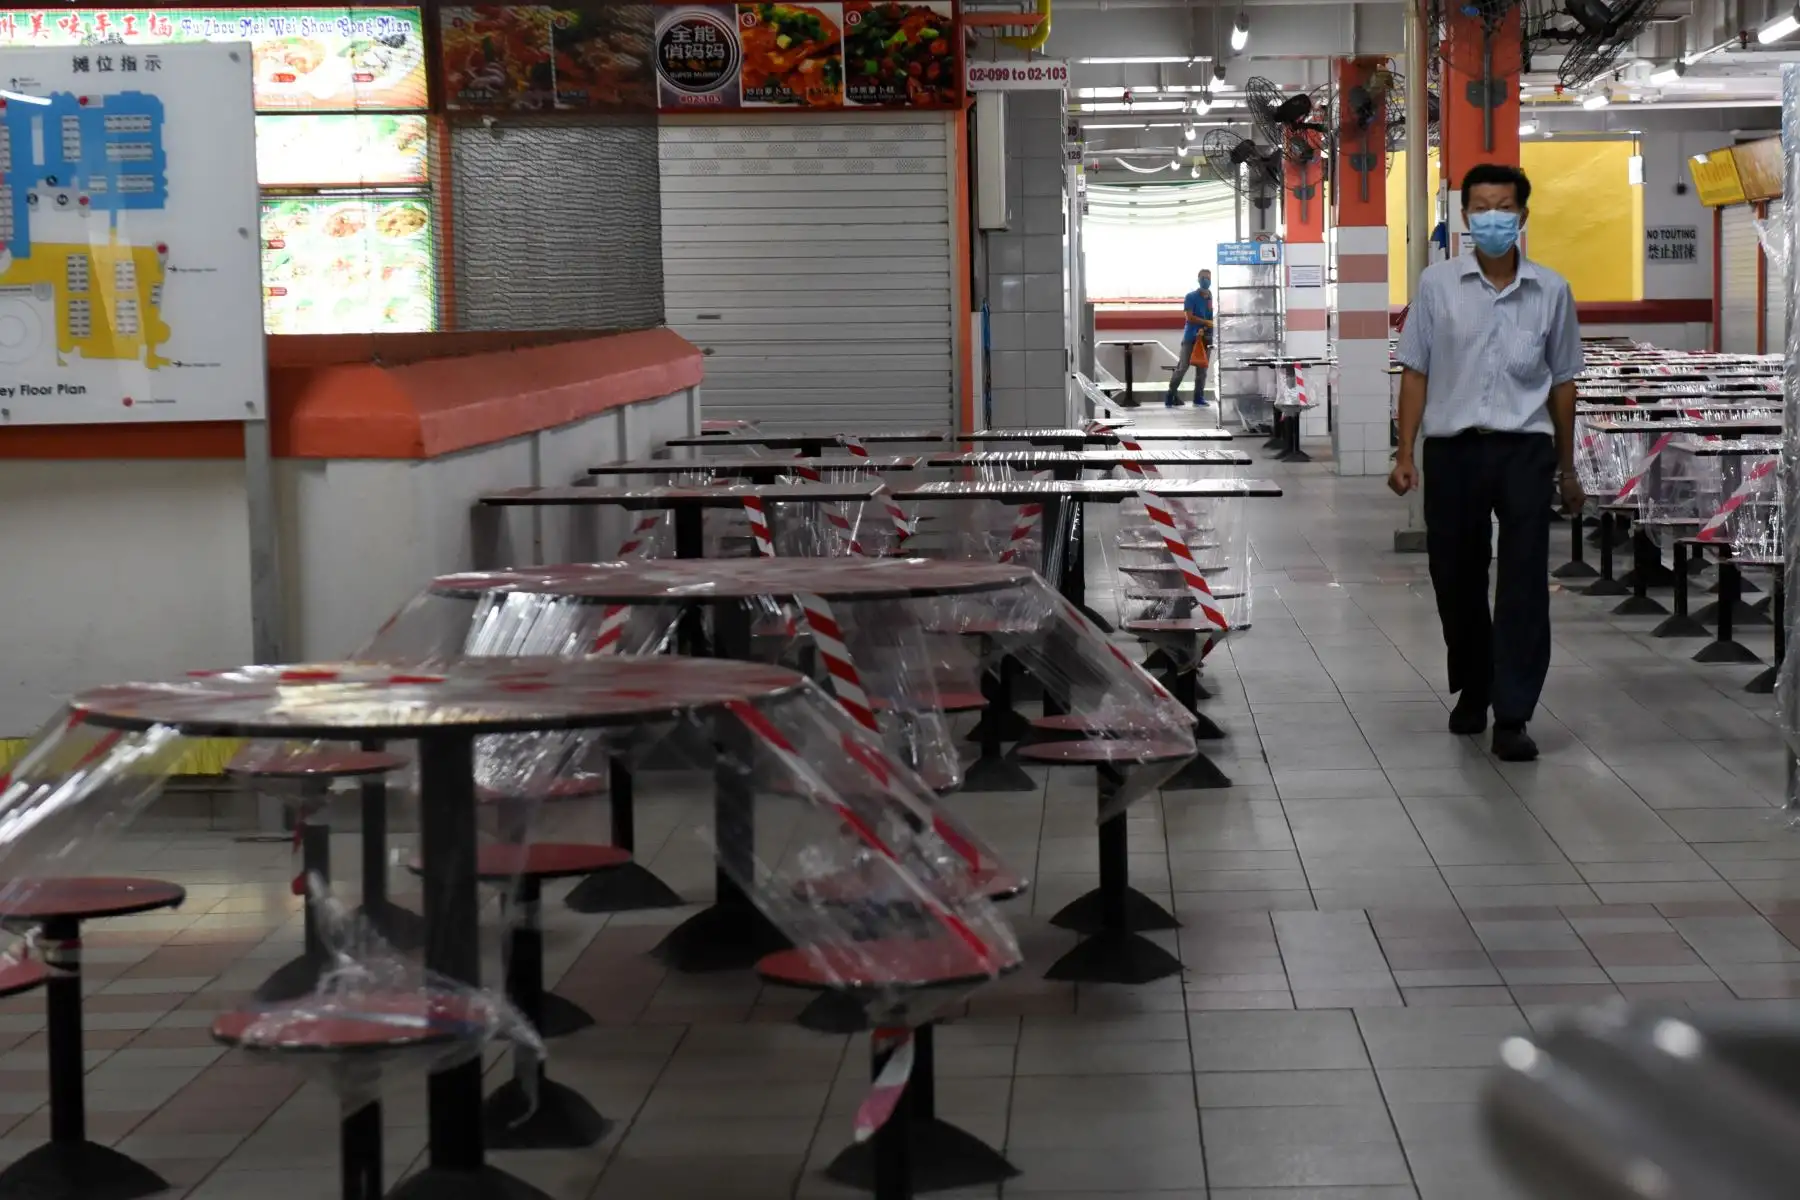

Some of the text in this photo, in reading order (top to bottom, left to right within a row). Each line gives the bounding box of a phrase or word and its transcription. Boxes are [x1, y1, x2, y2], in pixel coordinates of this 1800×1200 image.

[181, 16, 413, 38] Fu Zhou Mei Wei Shou Gong Mian
[670, 24, 717, 43] 全能
[663, 43, 725, 59] 俏妈妈
[969, 66, 1067, 81] 02-099 to 02-103
[1646, 229, 1696, 239] NO TOUTING
[20, 384, 53, 396] Floor
[57, 383, 87, 395] Plan
